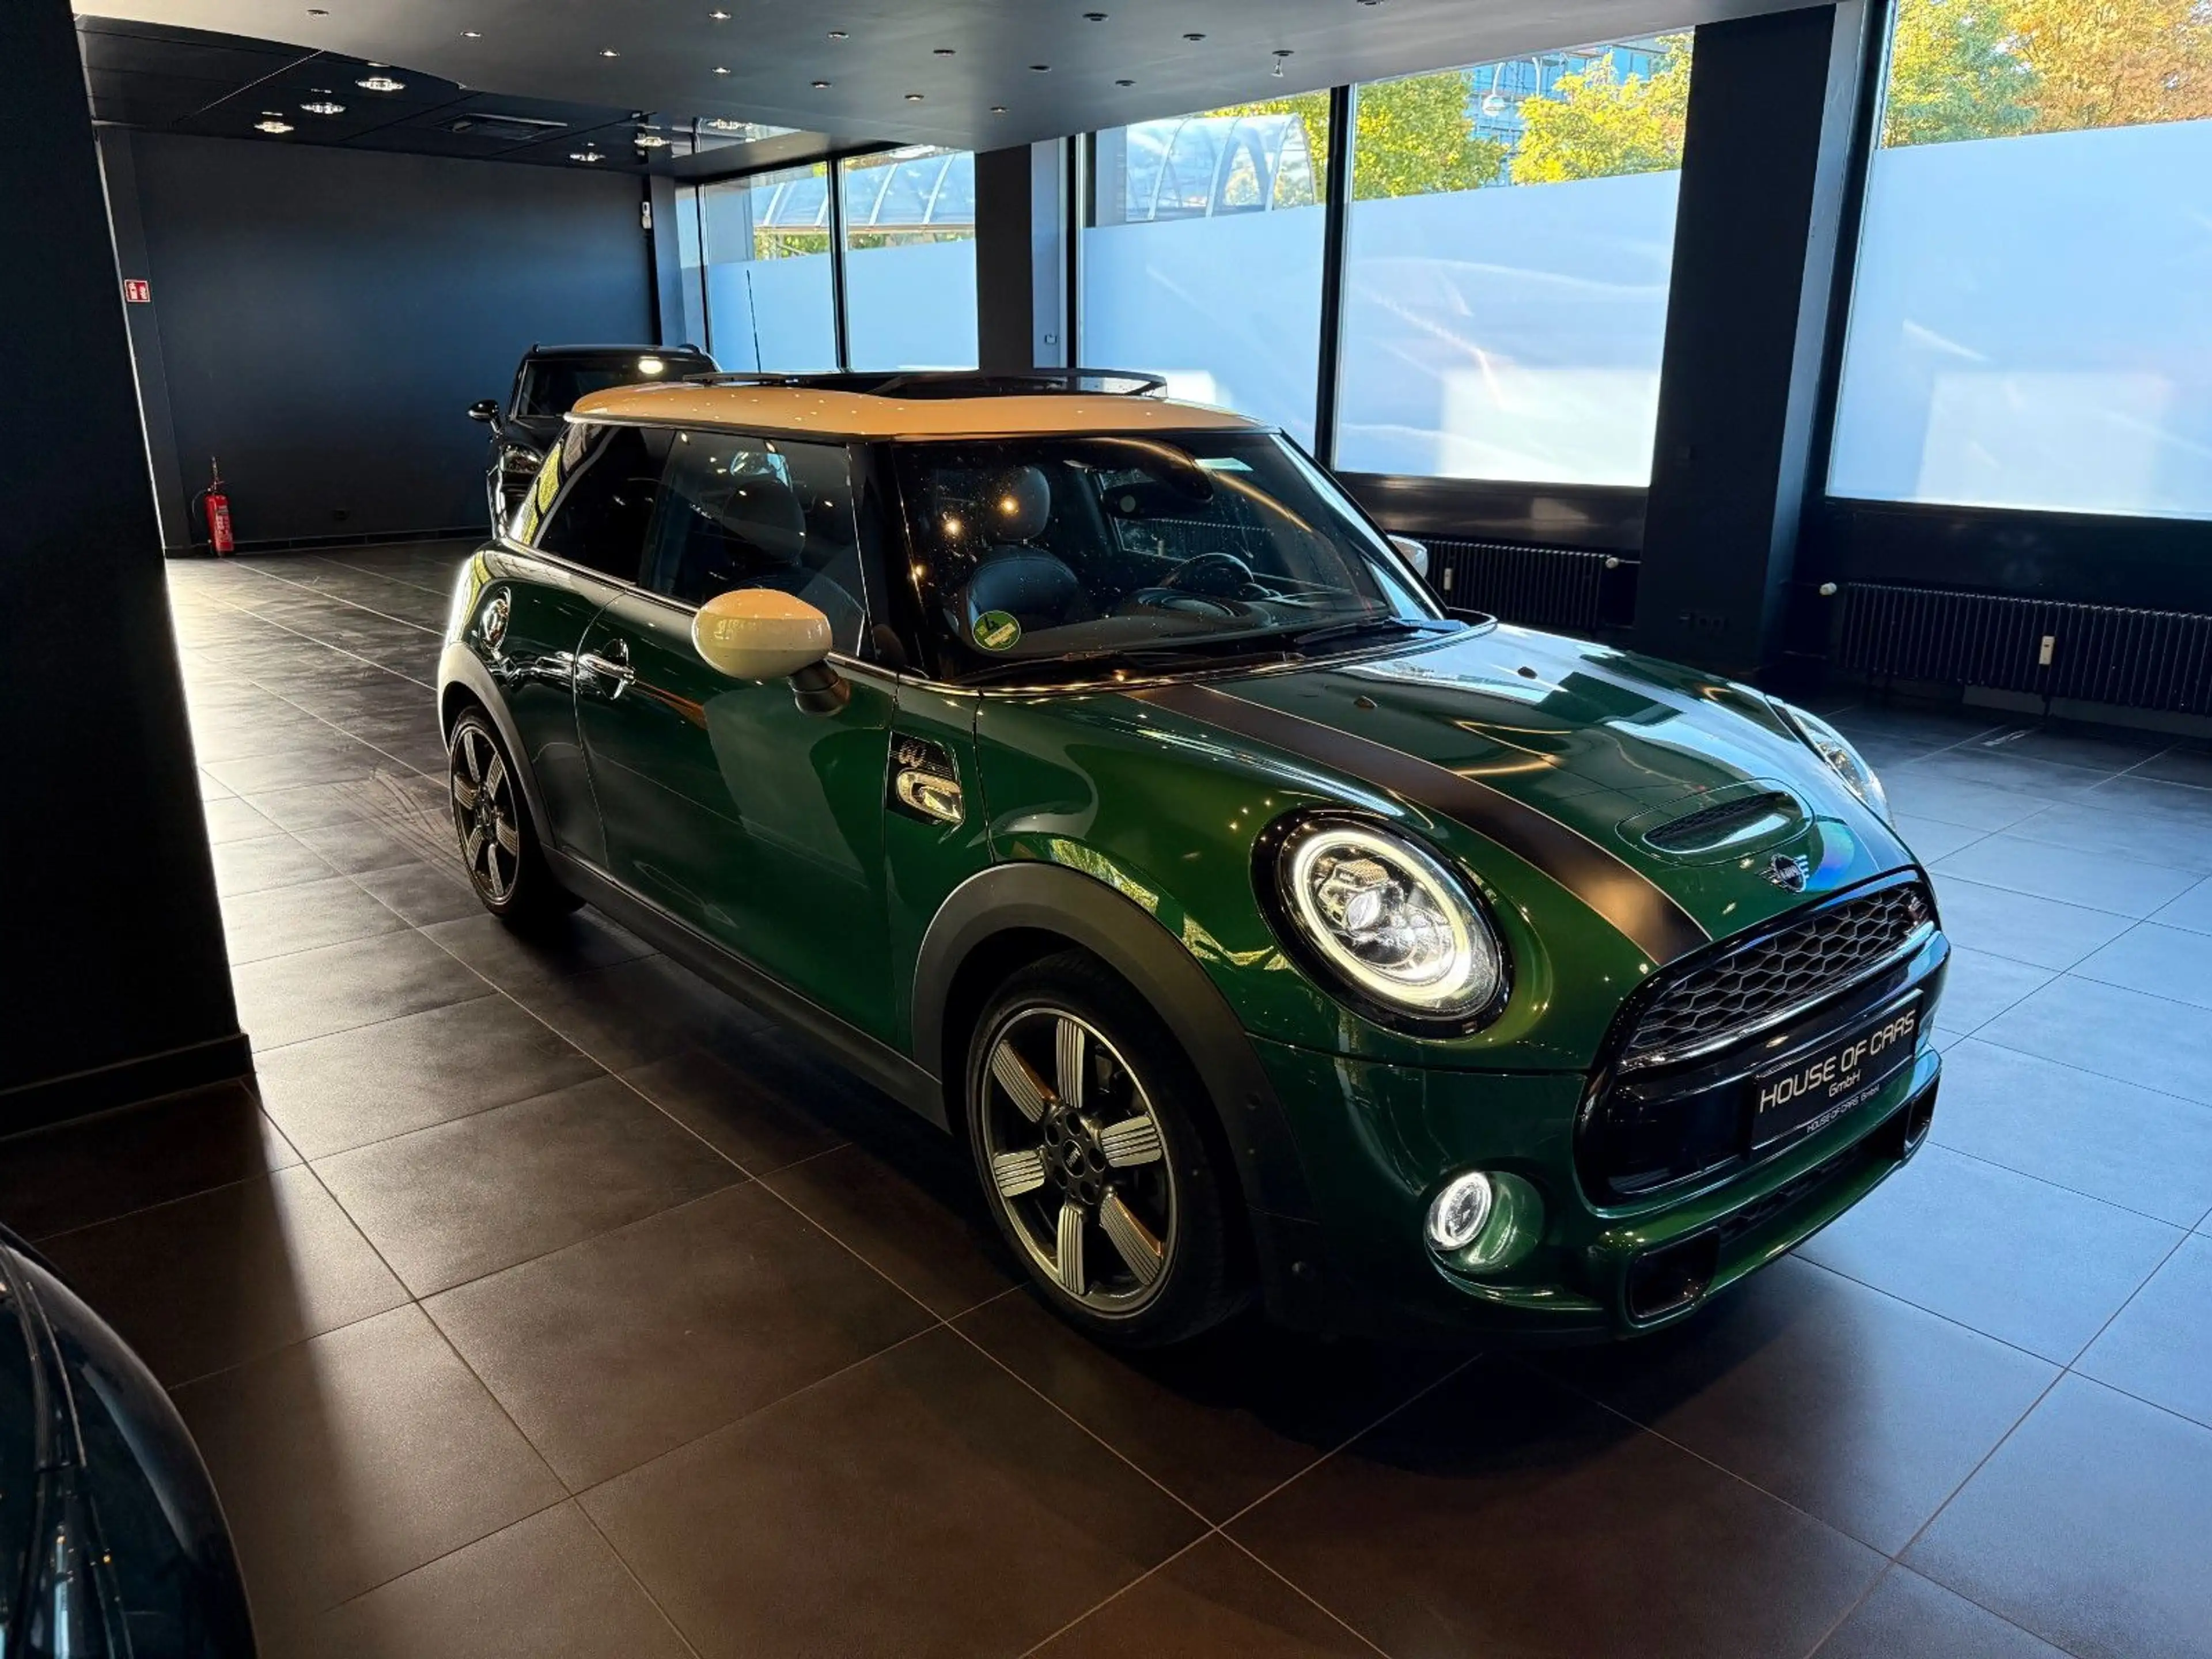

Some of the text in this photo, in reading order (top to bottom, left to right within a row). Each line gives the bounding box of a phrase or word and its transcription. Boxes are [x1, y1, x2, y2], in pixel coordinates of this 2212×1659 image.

[1759, 1009, 1916, 1114] HOUSE OF CARS
[1828, 1069, 1861, 1097] GmbH
